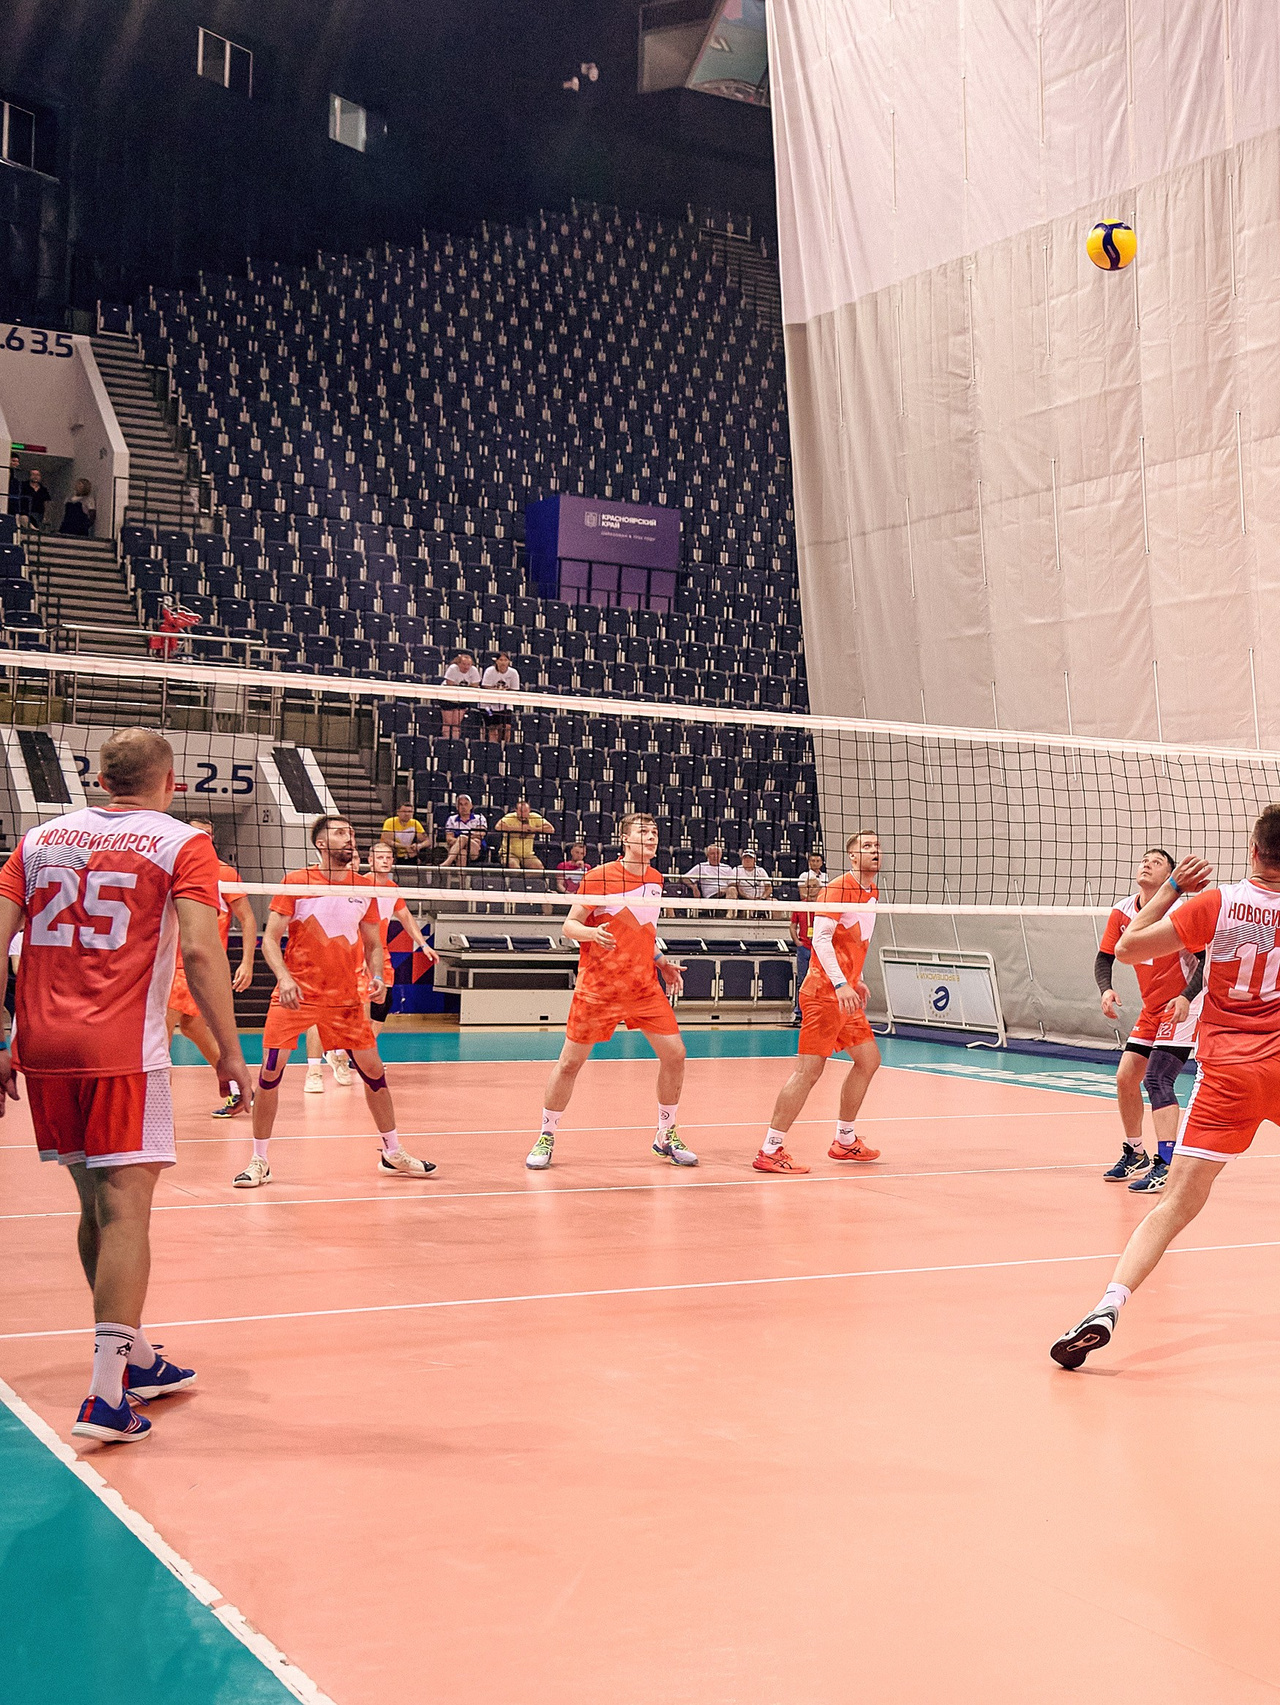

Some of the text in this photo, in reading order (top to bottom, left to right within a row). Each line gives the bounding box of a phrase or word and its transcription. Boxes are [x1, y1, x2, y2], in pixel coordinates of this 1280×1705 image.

[30, 330, 73, 357] 3.5
[195, 763, 254, 795] 2.5
[36, 829, 164, 853] НОВОСИБИРСК
[30, 866, 138, 950] 25
